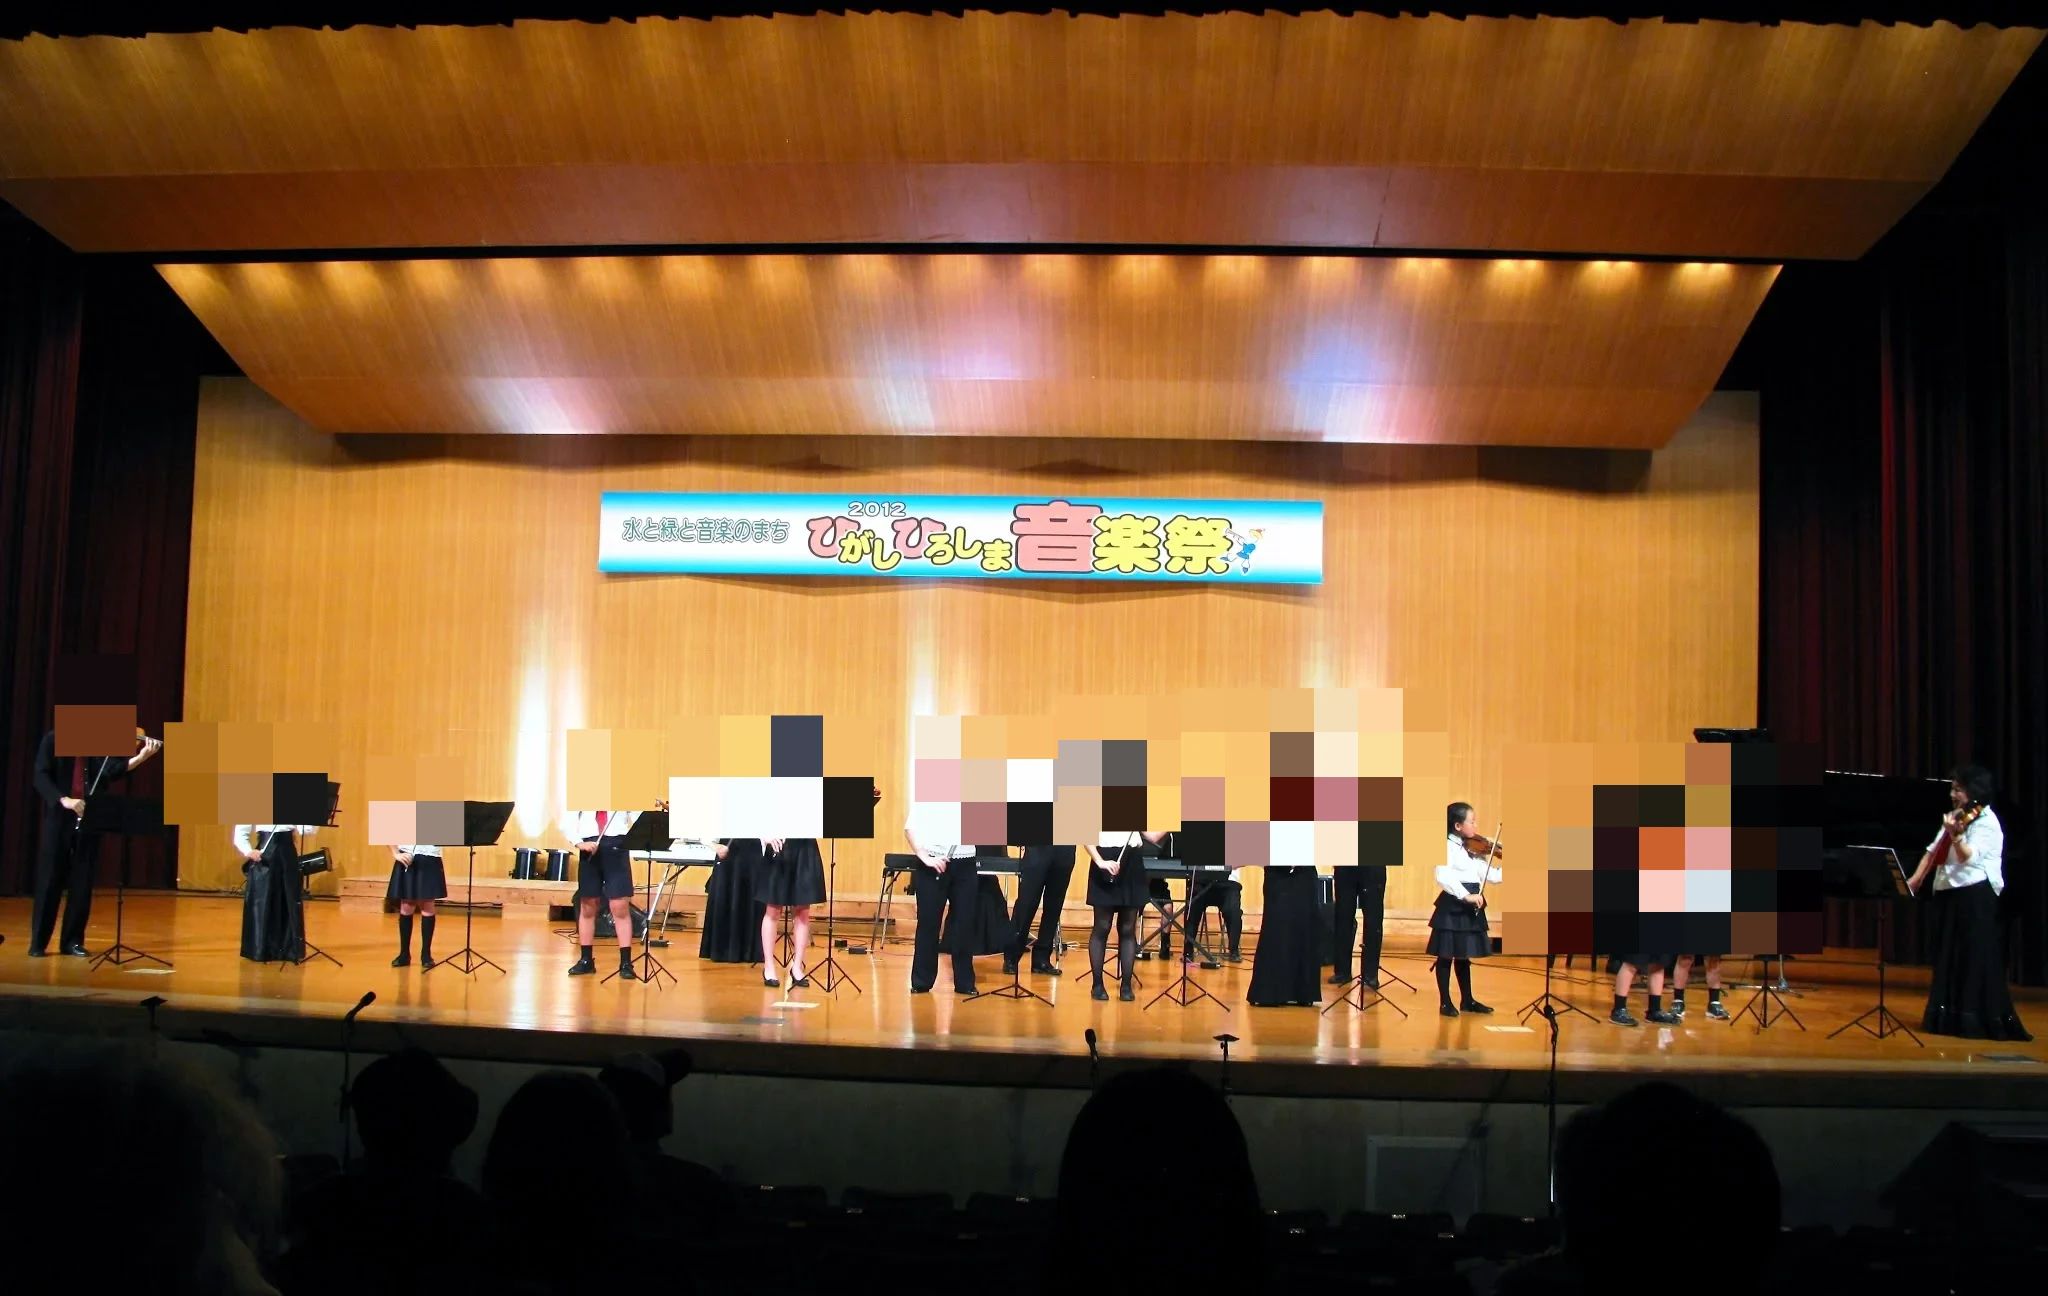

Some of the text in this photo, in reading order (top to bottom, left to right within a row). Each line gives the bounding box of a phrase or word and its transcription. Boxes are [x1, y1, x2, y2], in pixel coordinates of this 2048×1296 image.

[848, 501, 906, 517] 2012
[622, 517, 789, 544] 水と緑と音楽のまち
